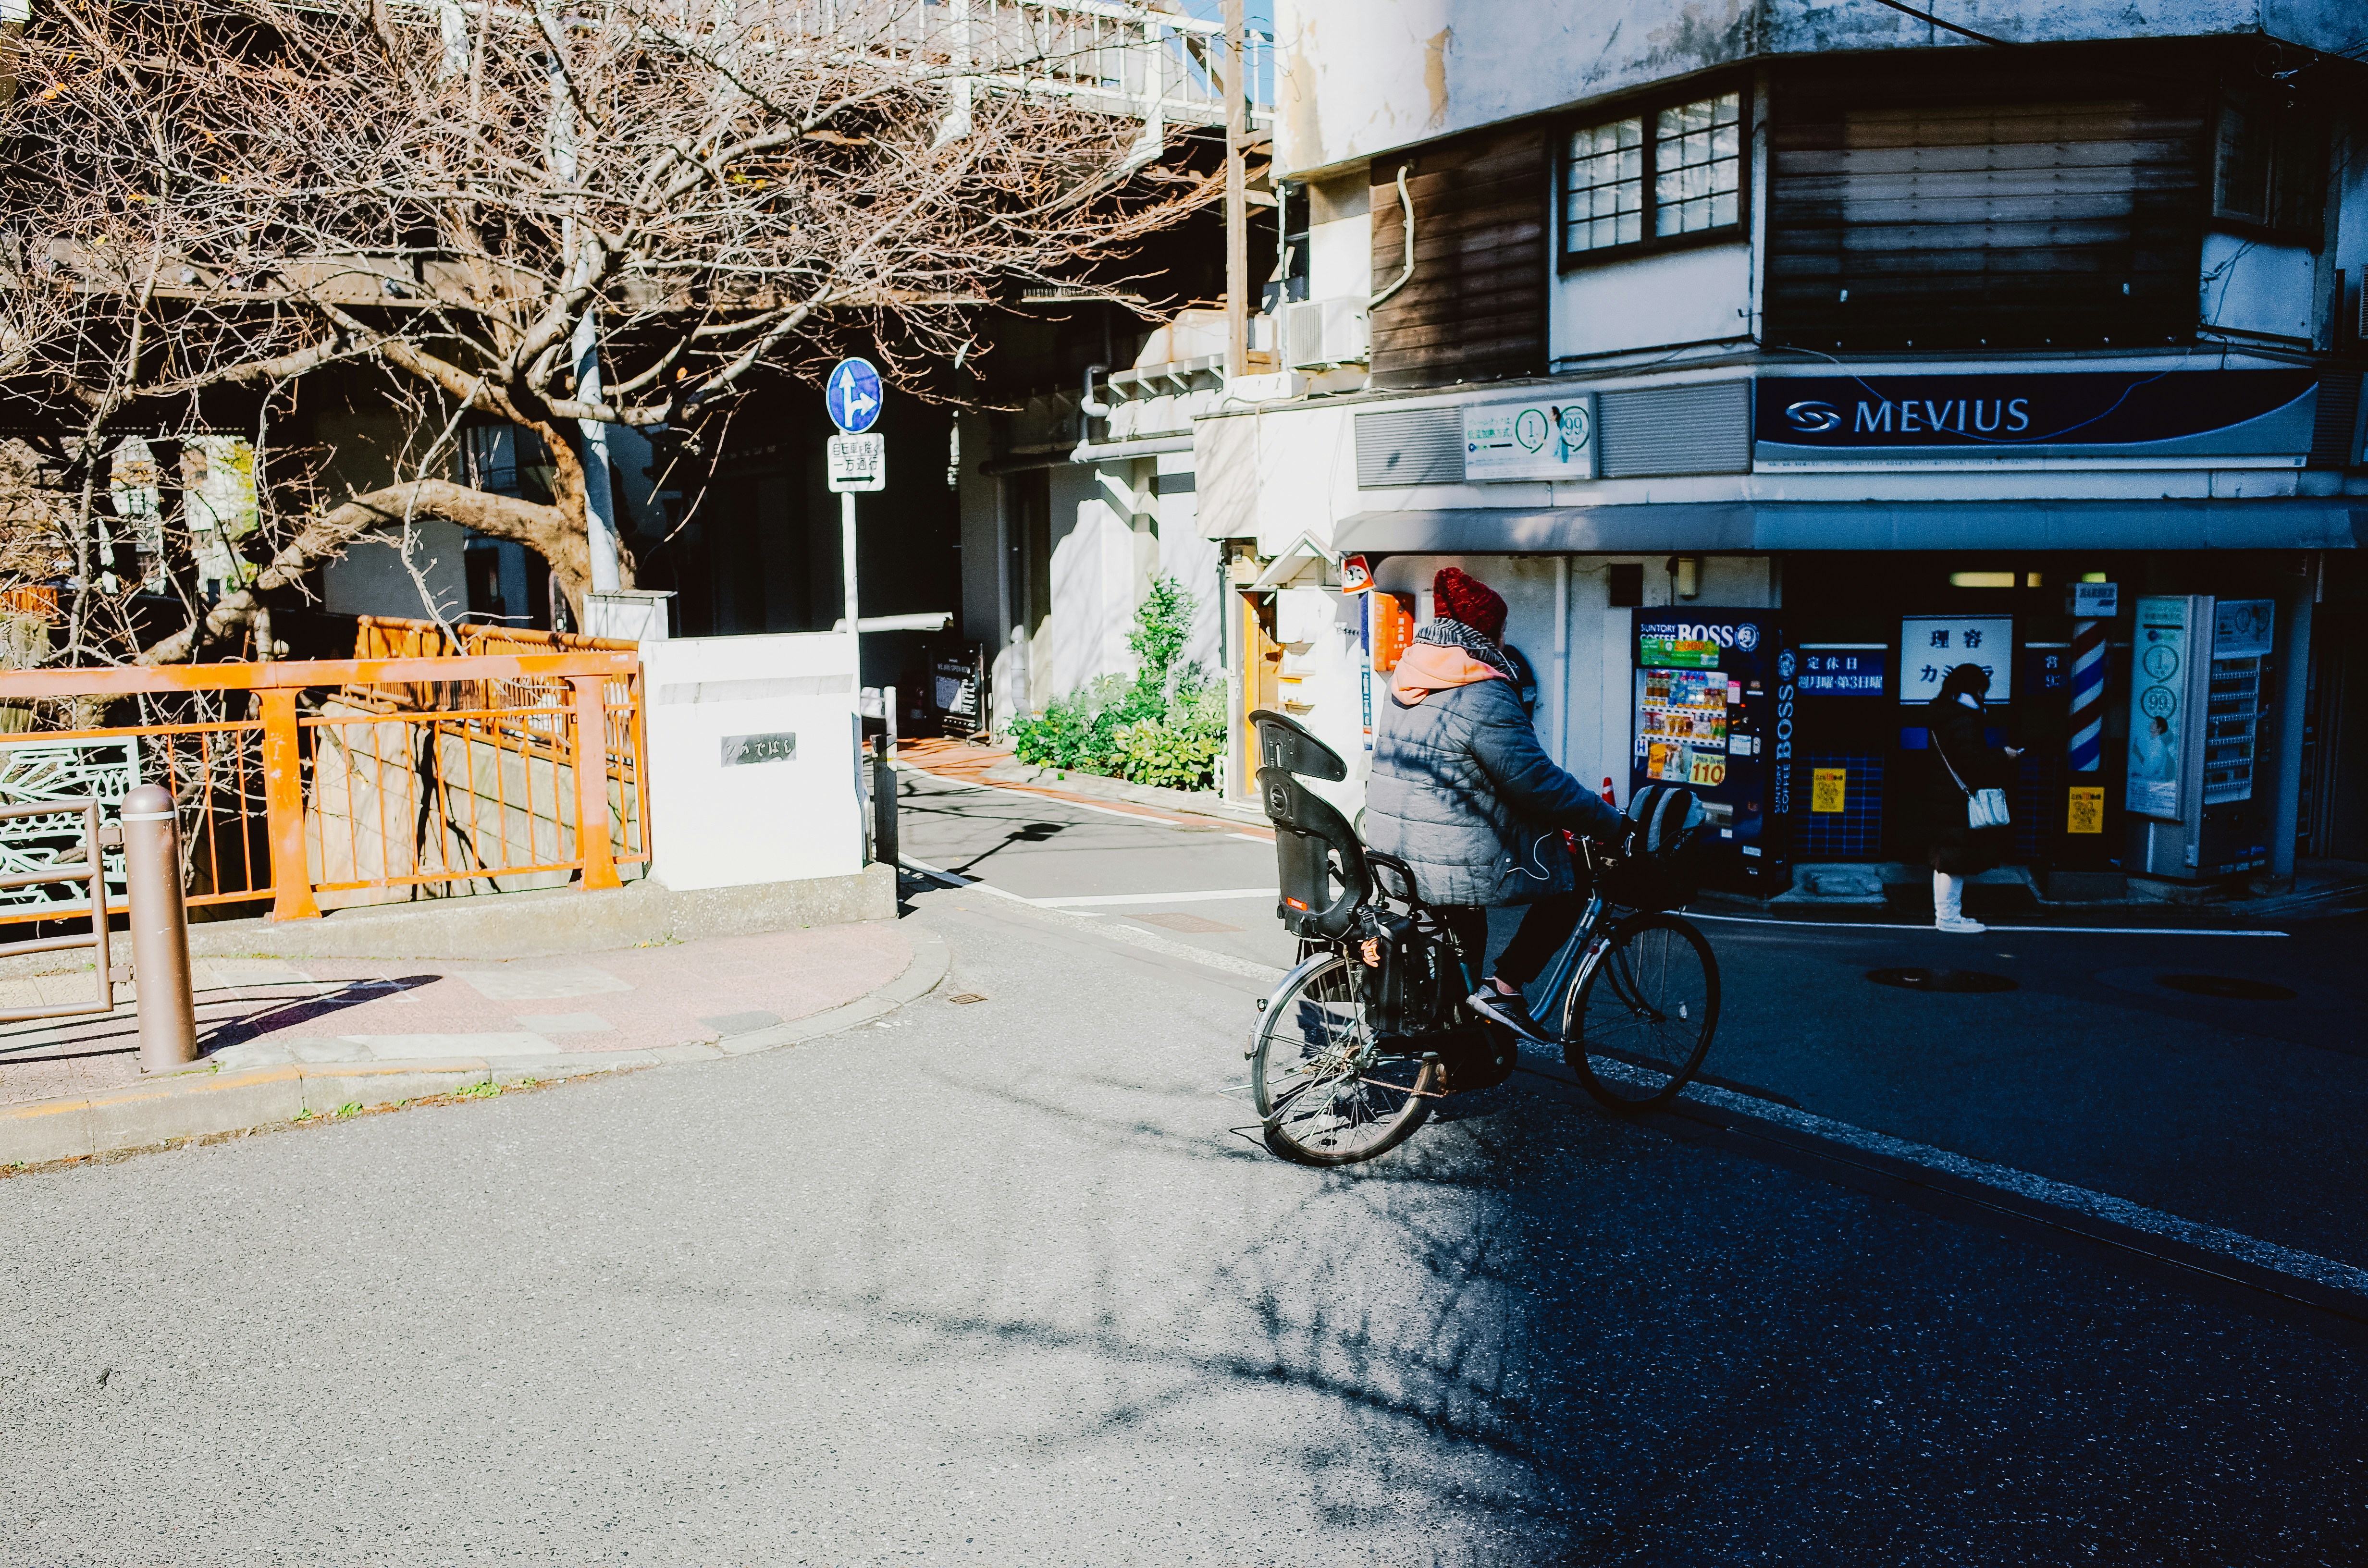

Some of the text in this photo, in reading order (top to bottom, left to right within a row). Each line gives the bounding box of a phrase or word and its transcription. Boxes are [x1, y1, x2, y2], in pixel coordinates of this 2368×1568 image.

[1854, 398, 2029, 432] MEVIUS
[834, 457, 878, 471] 一方通行
[1640, 624, 1676, 633] SUNTORY
[1677, 624, 1734, 648] BOSS
[1930, 629, 1983, 649] 理容
[1806, 656, 1858, 670] 定休日
[1776, 684, 1794, 760] BOSS
[1693, 763, 1724, 784] 110
[1782, 763, 1790, 813] COFFEE
